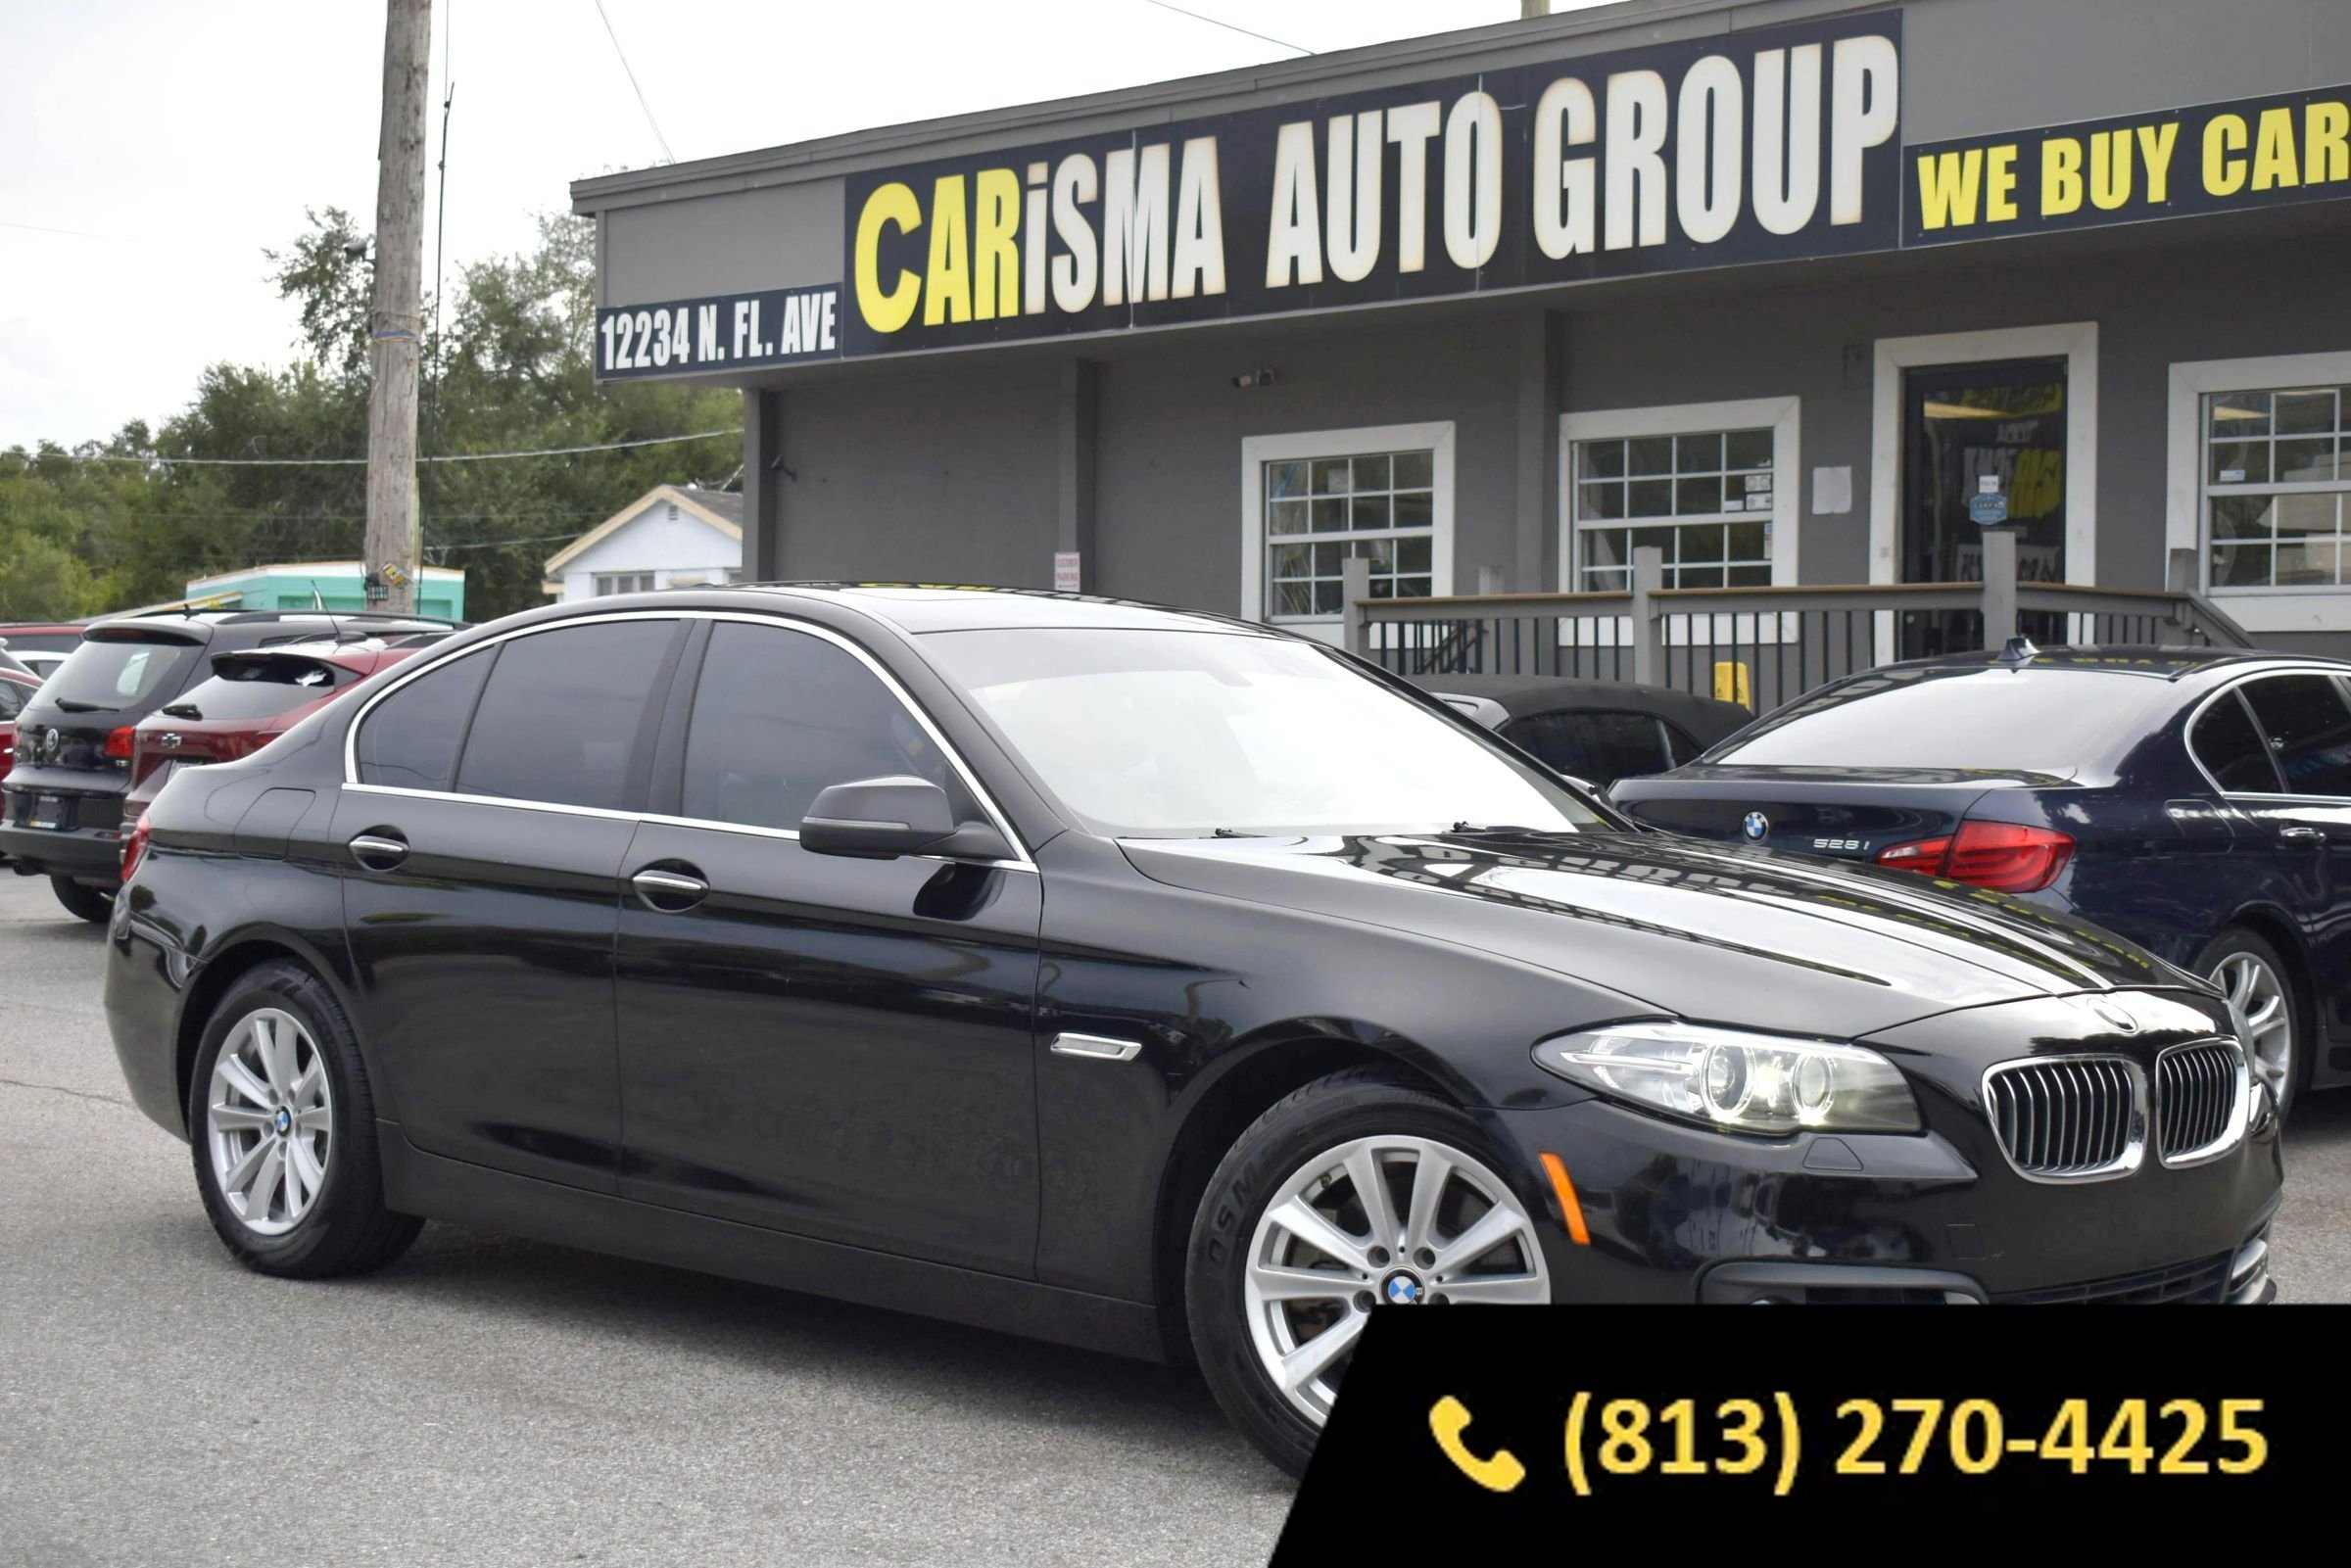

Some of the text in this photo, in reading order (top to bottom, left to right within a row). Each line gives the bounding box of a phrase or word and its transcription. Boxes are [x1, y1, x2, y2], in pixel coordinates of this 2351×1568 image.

[1265, 90, 1504, 289] AUTO
[1532, 35, 1899, 261] GROUP
[1917, 144, 2018, 230] WE
[2040, 122, 2181, 217] BUY
[600, 291, 837, 371] 12234 N. FL. AVE
